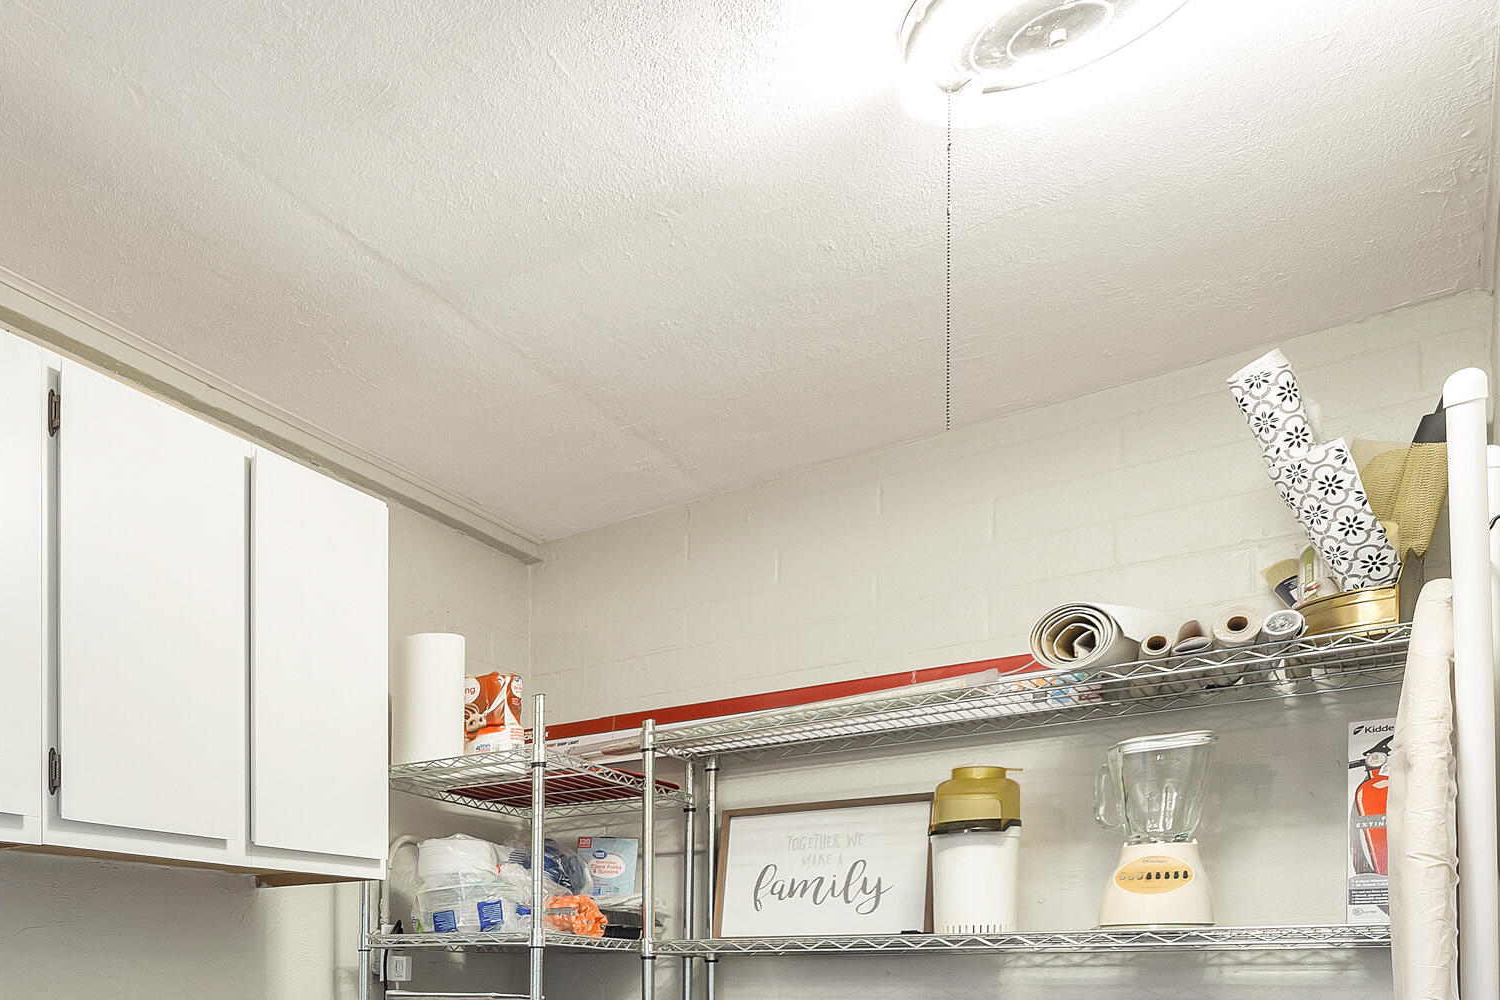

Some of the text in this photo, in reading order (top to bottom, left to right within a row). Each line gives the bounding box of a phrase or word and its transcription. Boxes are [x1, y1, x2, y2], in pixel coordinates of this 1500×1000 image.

[1364, 725, 1395, 734] Kidde
[786, 831, 866, 852] TOGETHER WE
[801, 854, 832, 869] MAKE
[753, 859, 894, 915] family
